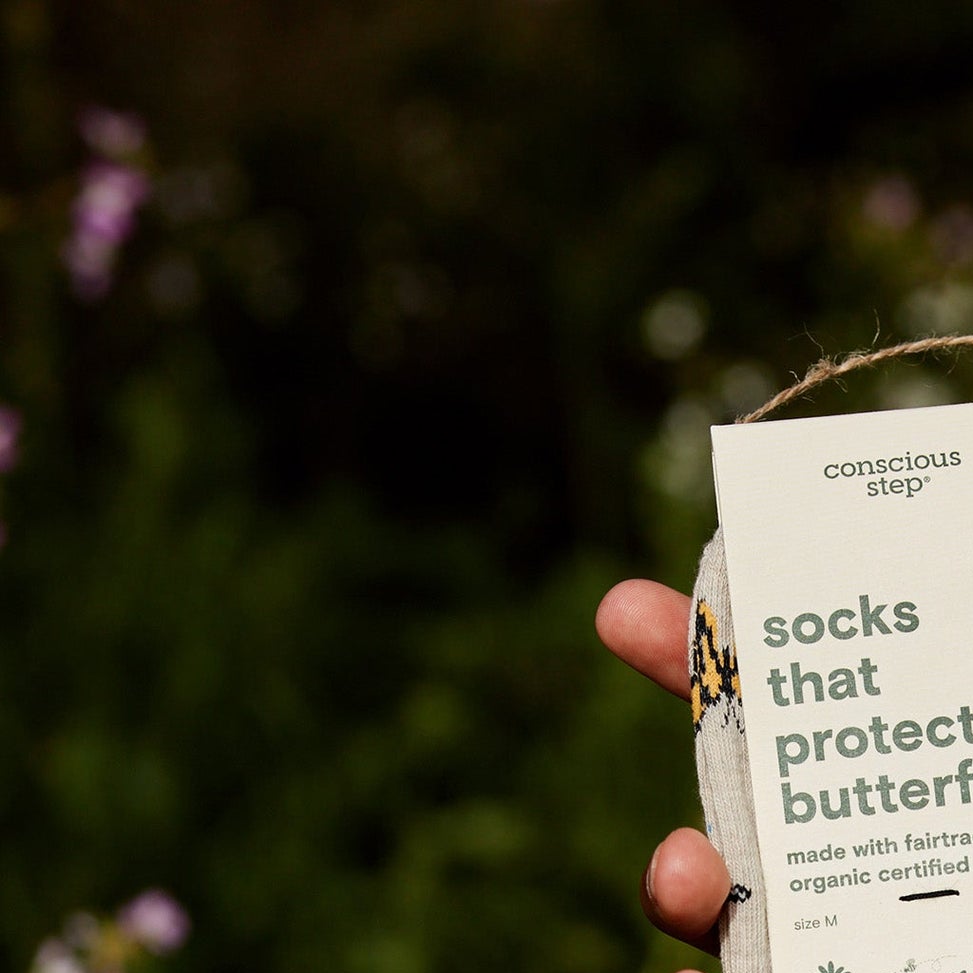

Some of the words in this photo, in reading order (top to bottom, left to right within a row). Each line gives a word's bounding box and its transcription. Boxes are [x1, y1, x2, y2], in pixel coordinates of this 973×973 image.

[824, 450, 962, 481] conscious
[763, 594, 920, 649] socks
[766, 657, 882, 708] that
[786, 843, 847, 866] made
[851, 837, 899, 858] with
[789, 867, 872, 895] organic
[878, 855, 970, 883] certified
[794, 918, 821, 931] size
[824, 914, 838, 928] M
